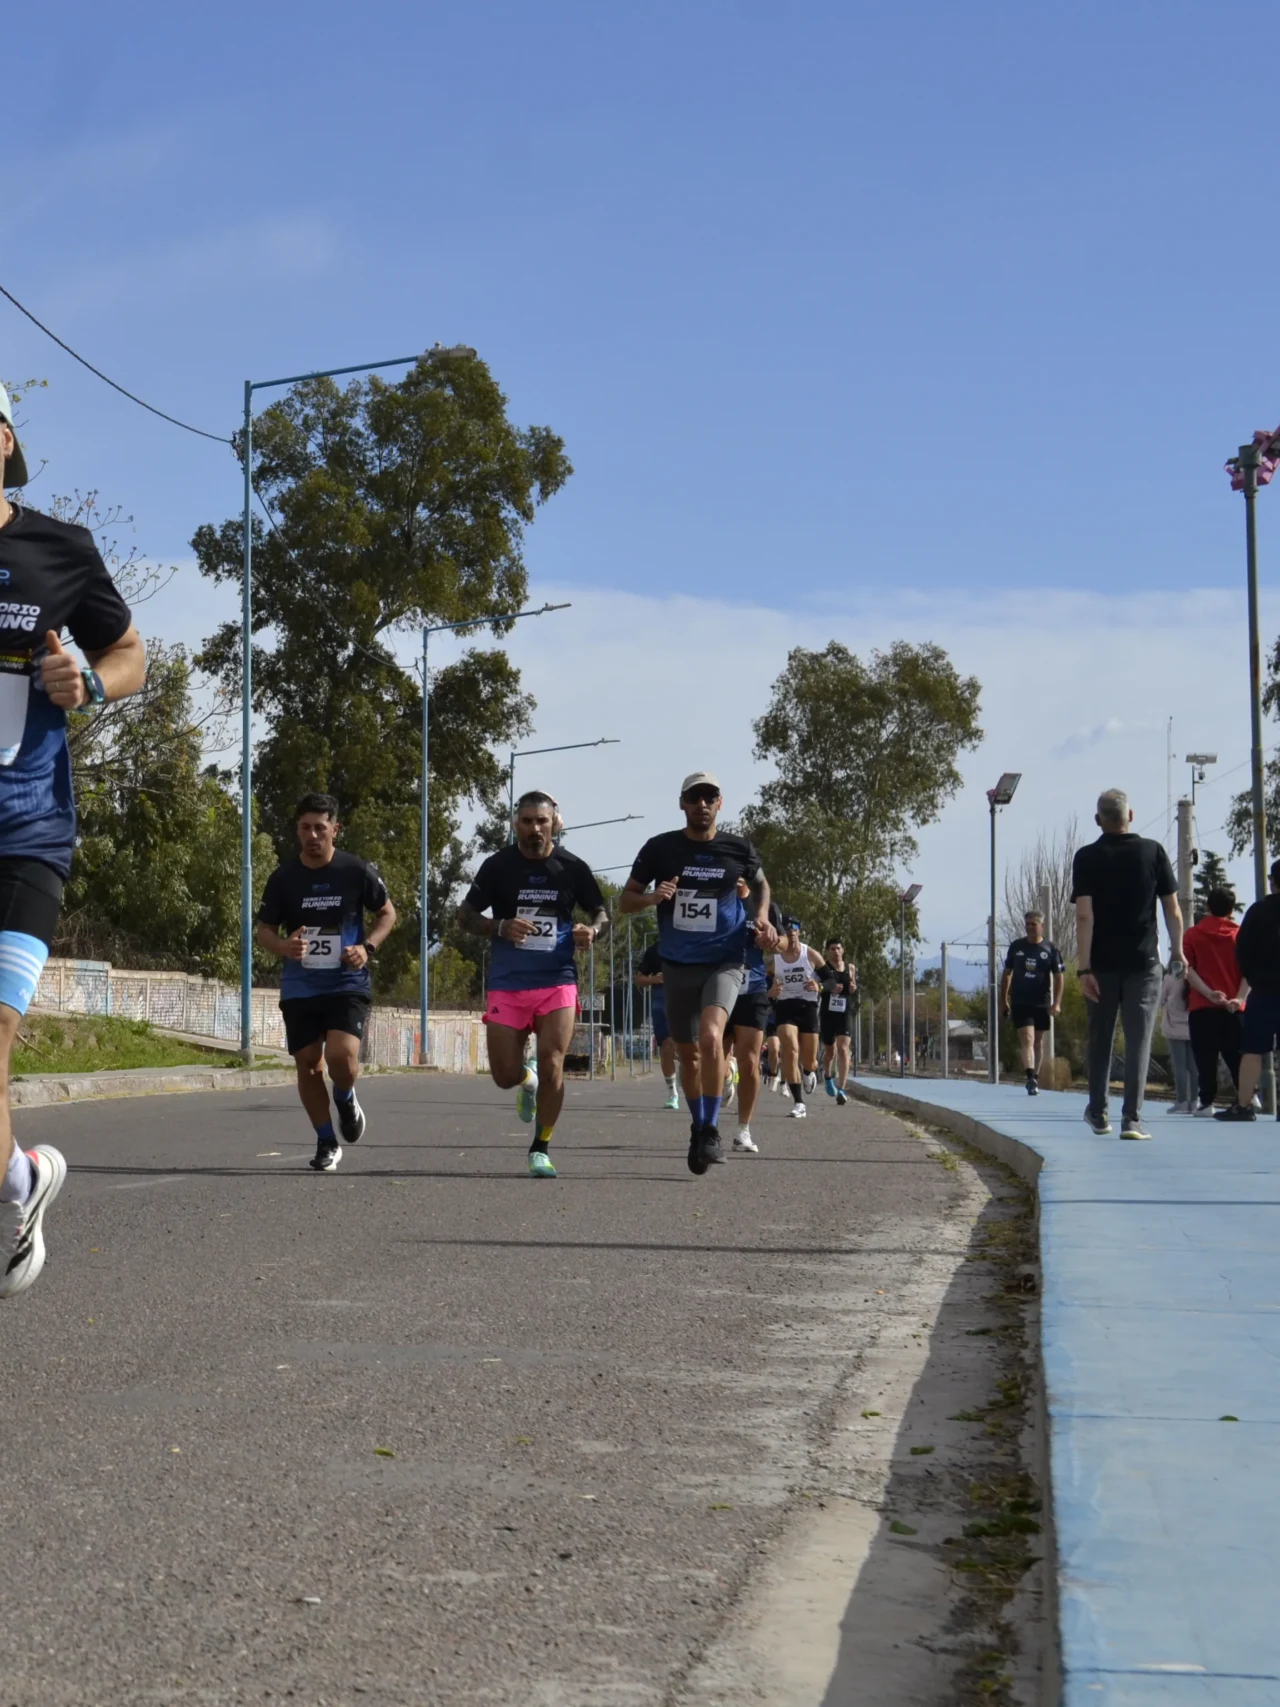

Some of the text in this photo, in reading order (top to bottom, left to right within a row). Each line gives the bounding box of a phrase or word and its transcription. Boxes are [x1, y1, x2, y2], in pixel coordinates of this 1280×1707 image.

[682, 870, 725, 879] RUNNING
[517, 893, 558, 901] RUNNING
[301, 900, 341, 909] RUNNING
[680, 902, 712, 919] 154
[527, 921, 553, 937] 52
[308, 940, 332, 956] 25
[785, 974, 804, 984] 562
